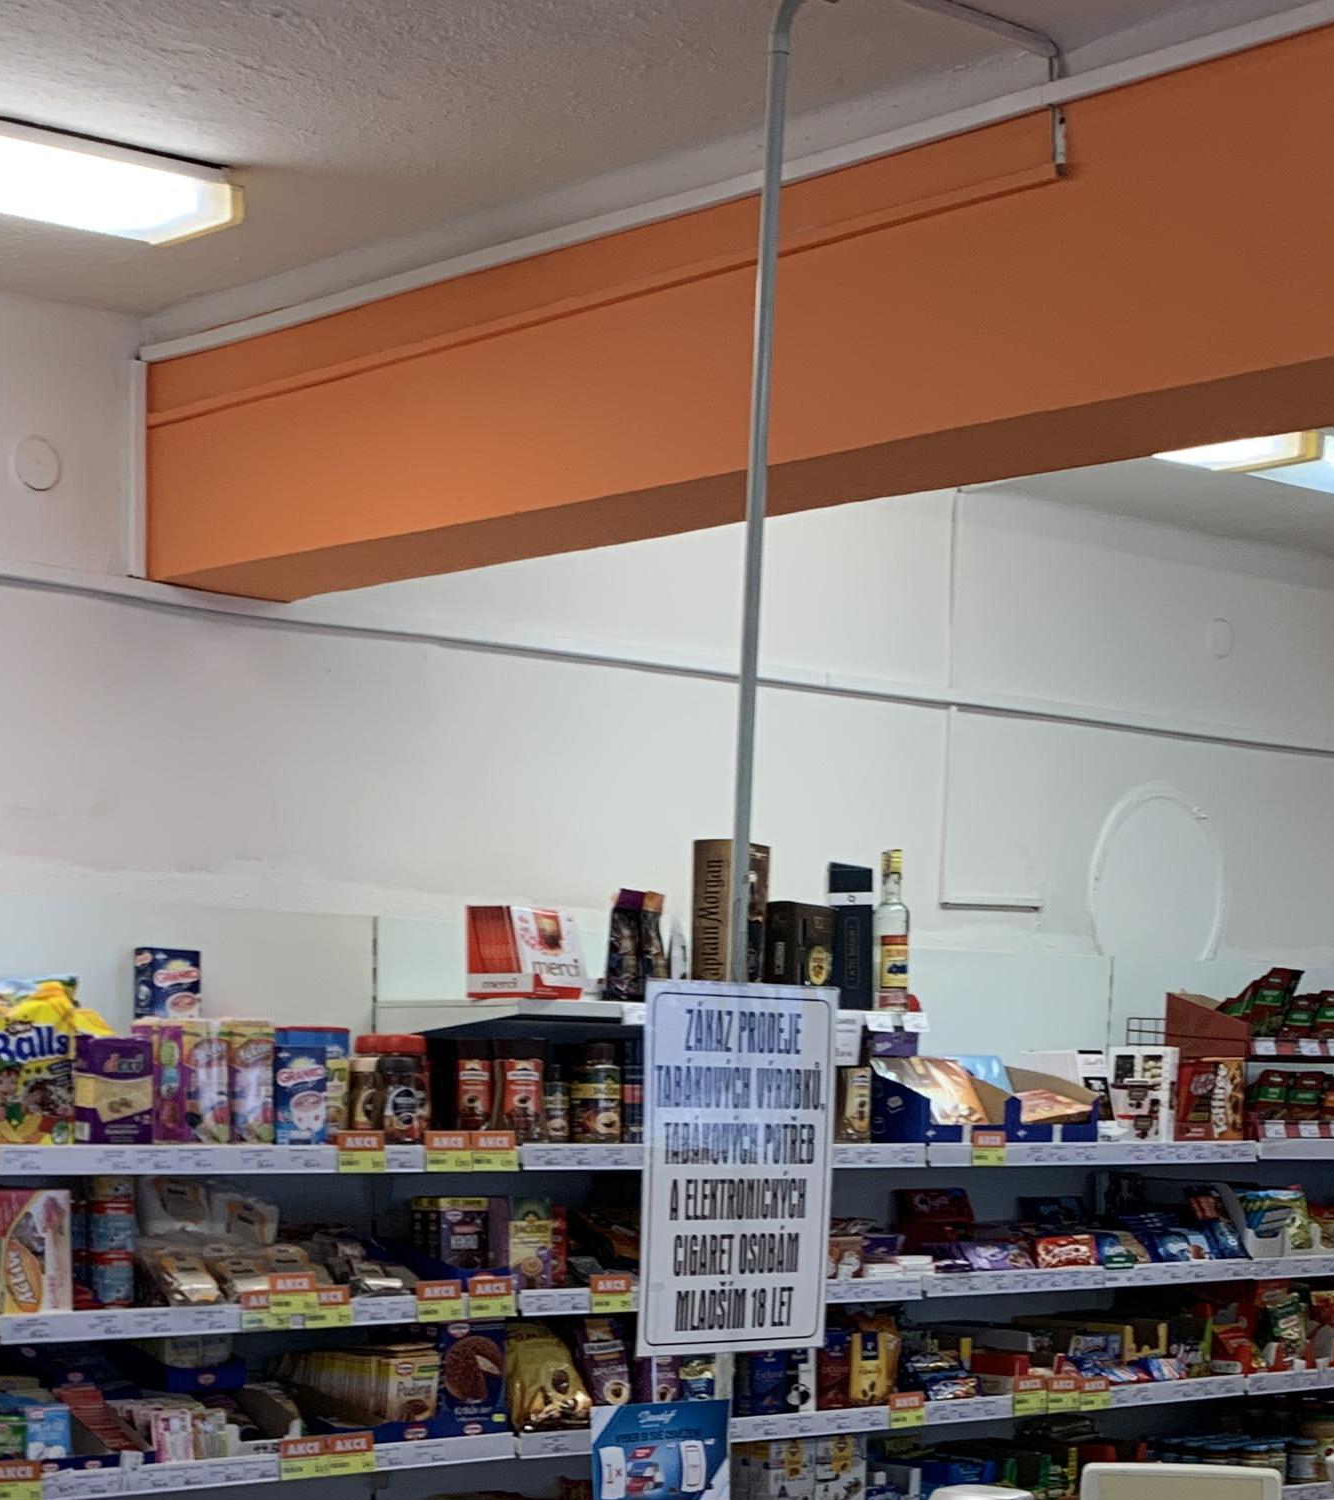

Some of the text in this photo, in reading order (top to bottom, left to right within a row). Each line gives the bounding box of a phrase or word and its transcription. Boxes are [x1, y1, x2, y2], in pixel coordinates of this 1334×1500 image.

[699, 859, 725, 981] aptain Morgan
[532, 959, 579, 977] merci
[481, 979, 517, 990] merci
[685, 1001, 803, 1055] ZÁKAZ PRODEJE
[655, 1057, 826, 1112] TABÁKOVÝCH VÝROBKŮ,
[433, 1134, 464, 1148] AKCE
[478, 1134, 509, 1148] AKCE
[664, 1115, 815, 1165] TABÁKOVÝCH POTŘEB
[669, 1171, 807, 1220] A ELEKTRONICKÝCH
[673, 1225, 800, 1276] CIGARET OSOBÁM
[275, 1277, 309, 1291] AKCE
[424, 1285, 456, 1297] AKCE
[476, 1282, 507, 1295] AKCE
[597, 1279, 627, 1291] AKCE
[674, 1281, 794, 1332] MLADŠÍM 18 LET
[287, 1442, 322, 1457] AKCE
[335, 1438, 368, 1453] AKCE
